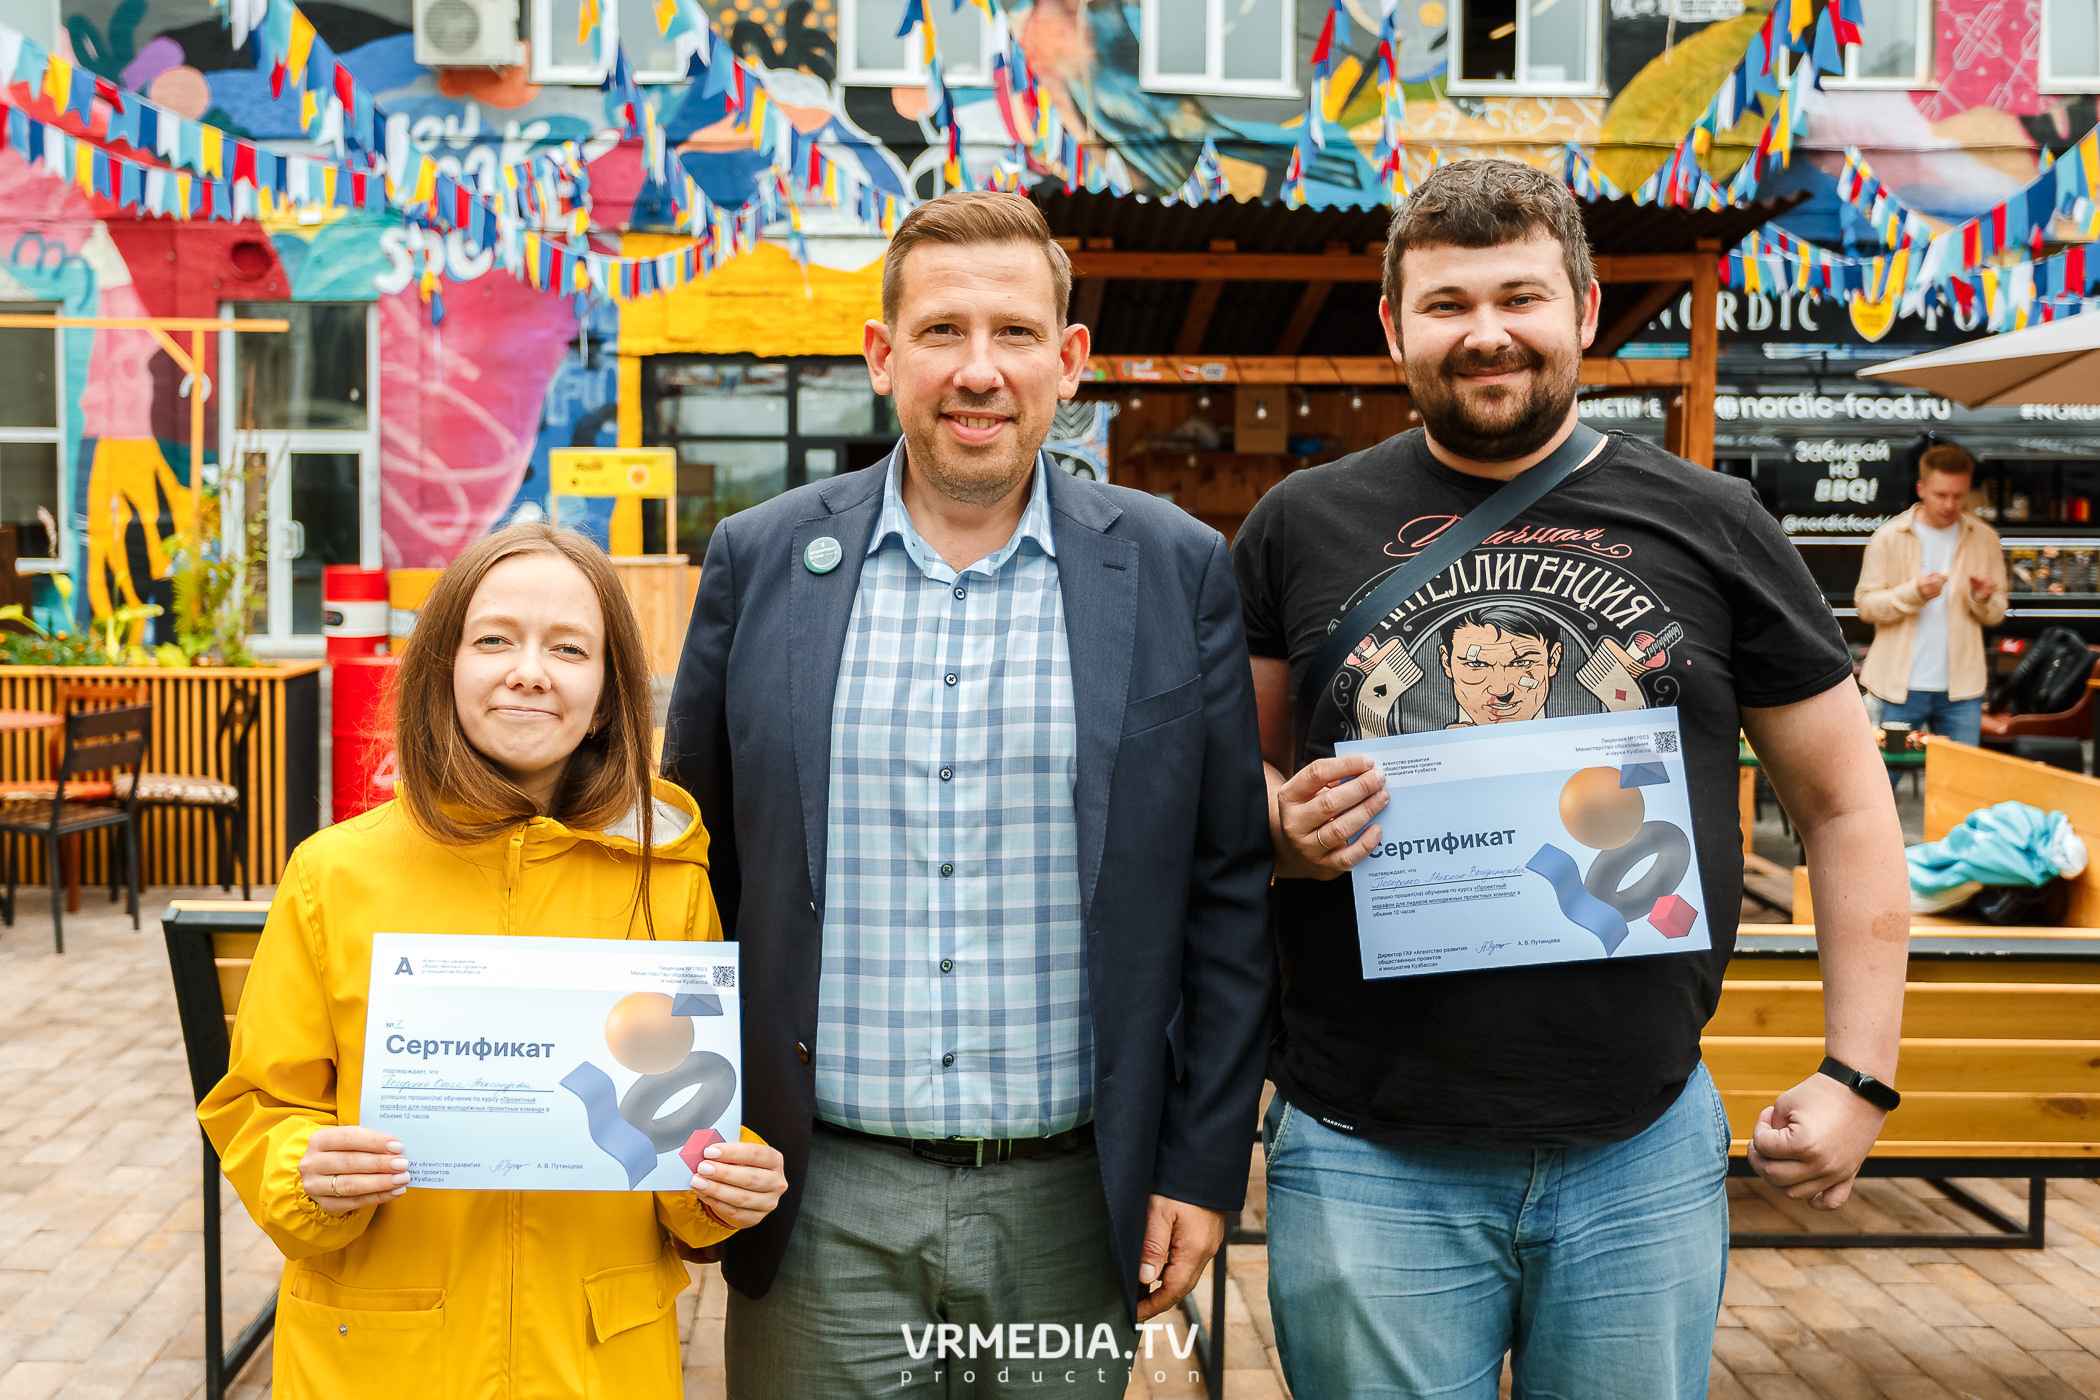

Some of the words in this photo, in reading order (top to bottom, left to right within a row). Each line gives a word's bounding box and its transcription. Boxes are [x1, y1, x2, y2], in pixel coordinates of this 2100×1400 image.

[1795, 439, 1891, 463] Забирай
[1828, 460, 1860, 479] на
[1814, 477, 1879, 504] BBQ!
[1368, 829, 1516, 860] Сертификат
[1370, 893, 1394, 902] успешно
[1394, 890, 1424, 900] прошел(ла)
[1424, 888, 1450, 897] обучение
[1457, 886, 1473, 894] курсу
[1371, 901, 1395, 910] марафон
[1395, 900, 1406, 908] для
[1406, 898, 1429, 907] лидеров
[1428, 895, 1463, 904] молодежных
[1463, 893, 1493, 902] проектных
[1372, 910, 1393, 918] объеме
[1530, 938, 1561, 946] Путинцева
[1377, 951, 1403, 960] Директор
[1443, 946, 1468, 954] развития
[1377, 956, 1416, 966] общественных
[1416, 954, 1442, 962] проектов
[386, 1034, 556, 1061] Сертификат
[380, 1094, 407, 1102] успешно
[407, 1094, 443, 1103] прошел(ла)
[443, 1095, 473, 1103] обучение
[379, 1103, 407, 1111] марафон
[420, 1104, 446, 1112] лидеров
[453, 1162, 481, 1170] развития
[551, 1163, 583, 1171] Путинцева
[421, 1169, 450, 1177] проектов
